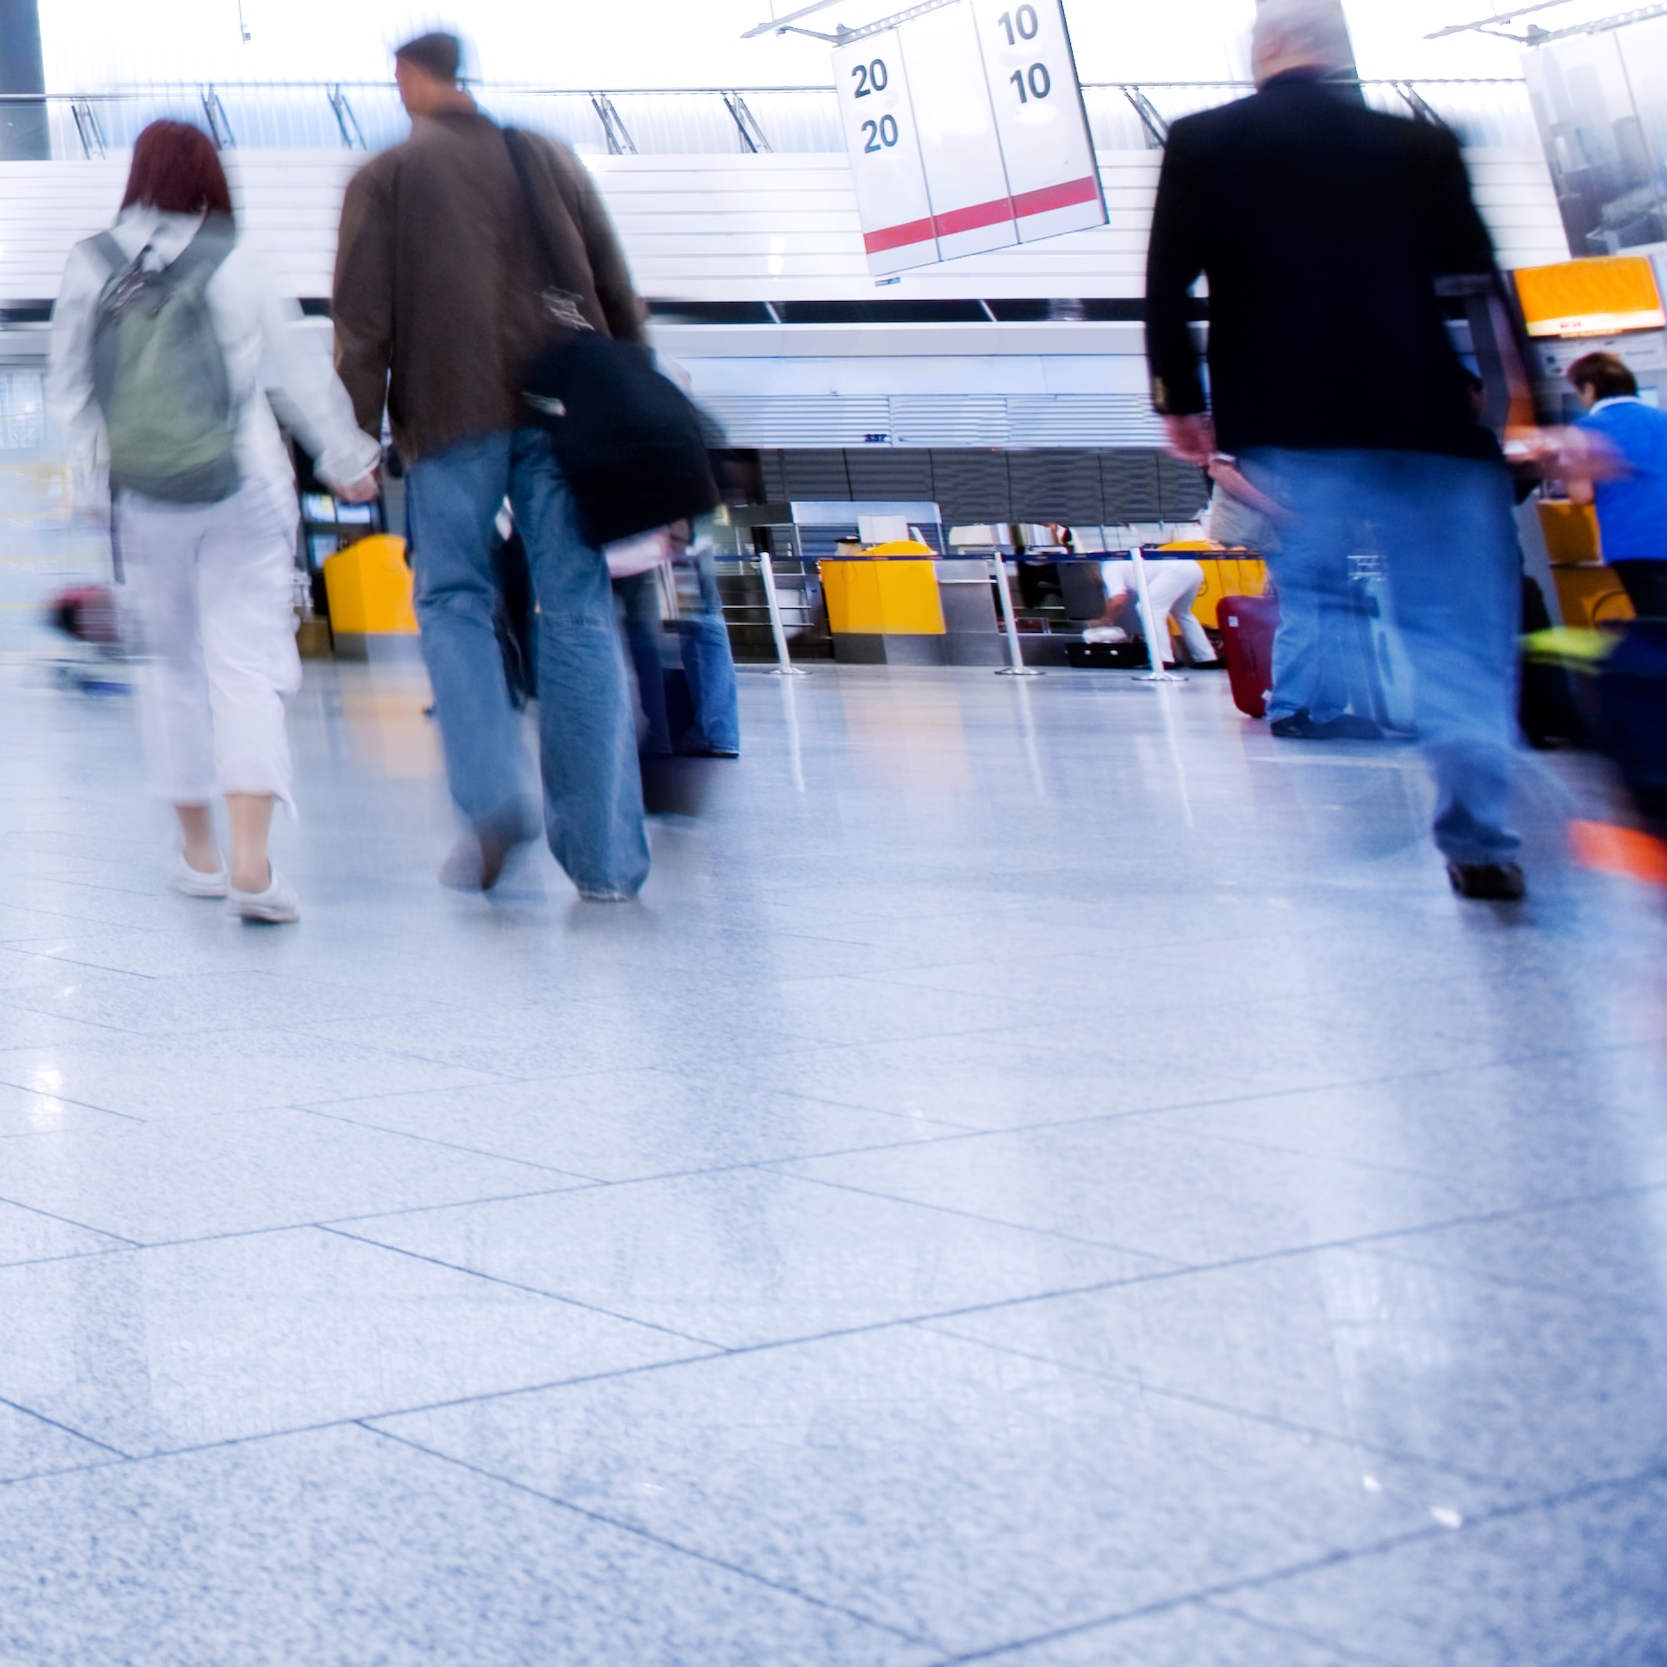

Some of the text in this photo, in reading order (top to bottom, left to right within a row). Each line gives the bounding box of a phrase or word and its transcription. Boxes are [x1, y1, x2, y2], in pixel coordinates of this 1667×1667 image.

[998, 4, 1038, 46] 10
[851, 58, 888, 99] 20
[1009, 62, 1051, 104] 10
[861, 114, 898, 154] 20
